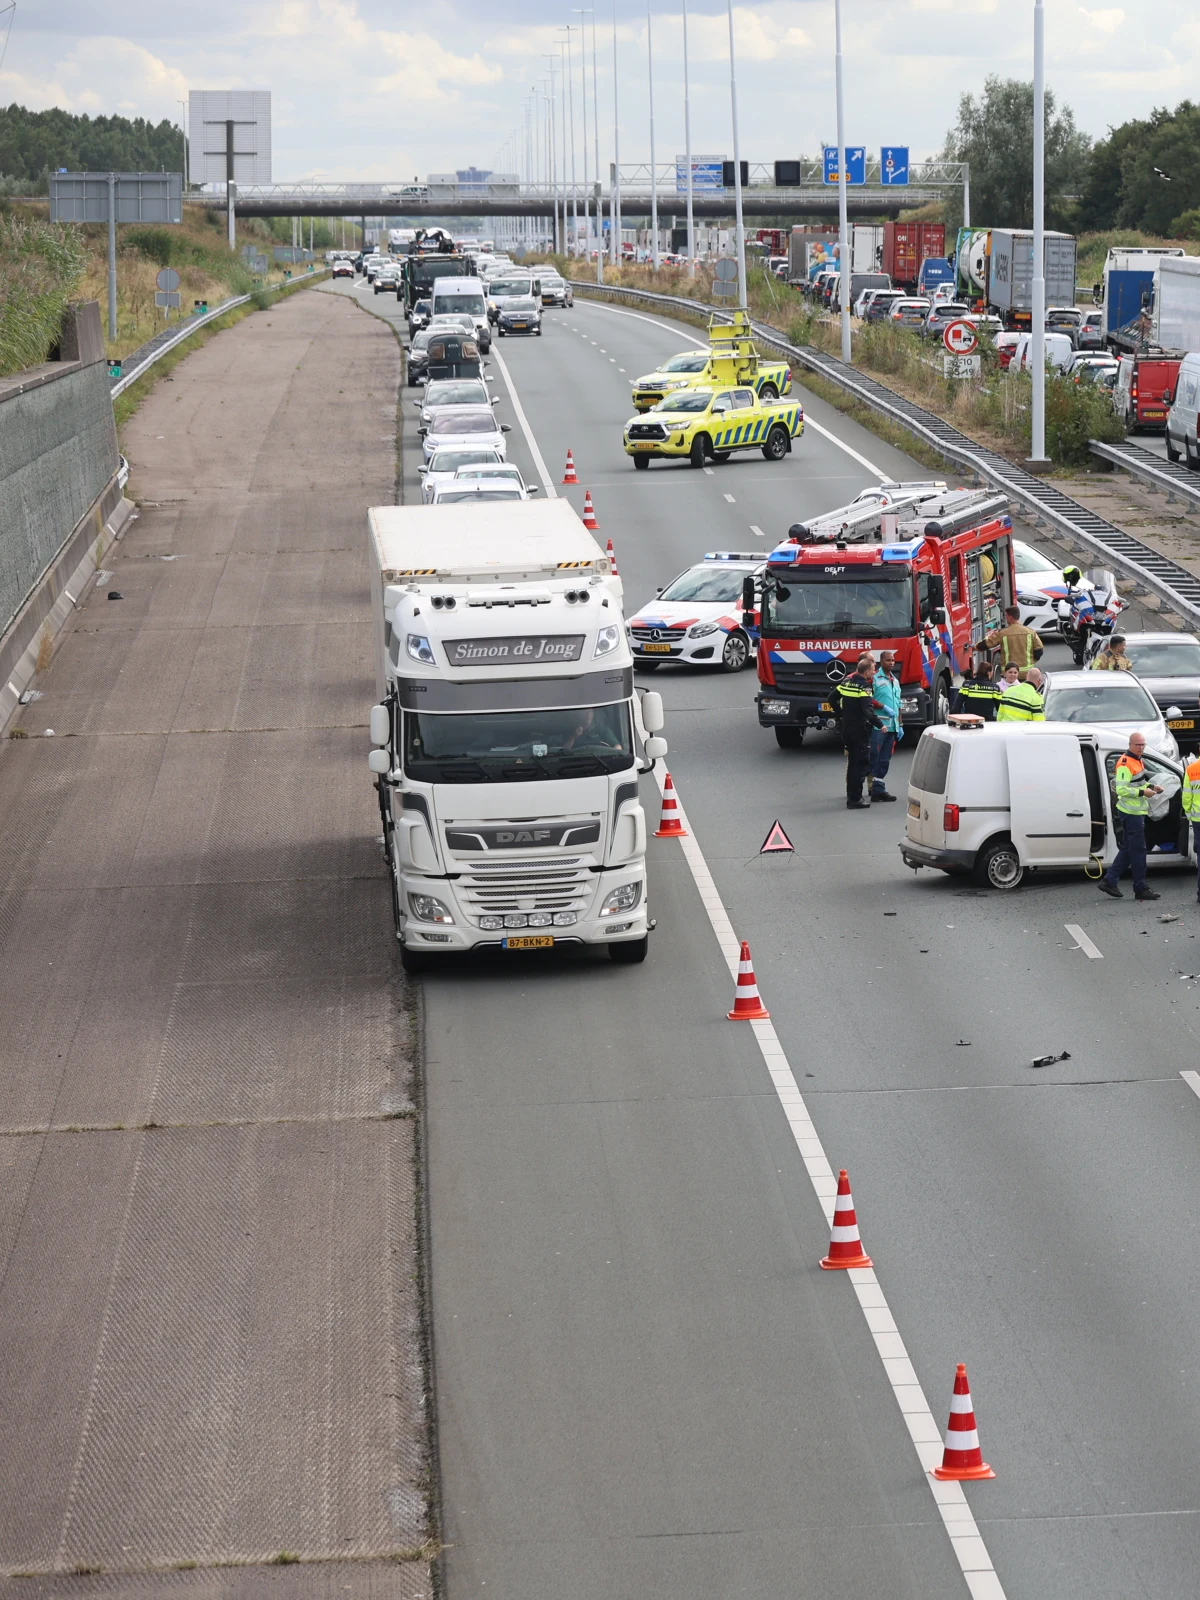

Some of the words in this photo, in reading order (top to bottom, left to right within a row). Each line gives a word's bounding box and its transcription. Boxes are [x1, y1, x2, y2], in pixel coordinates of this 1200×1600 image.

[454, 643, 509, 660] Simon
[512, 640, 533, 656] de
[535, 639, 576, 659] Jong
[799, 640, 872, 650] BRANDWEER
[496, 830, 551, 843] DAF
[509, 937, 551, 947] 87-BKN-2
